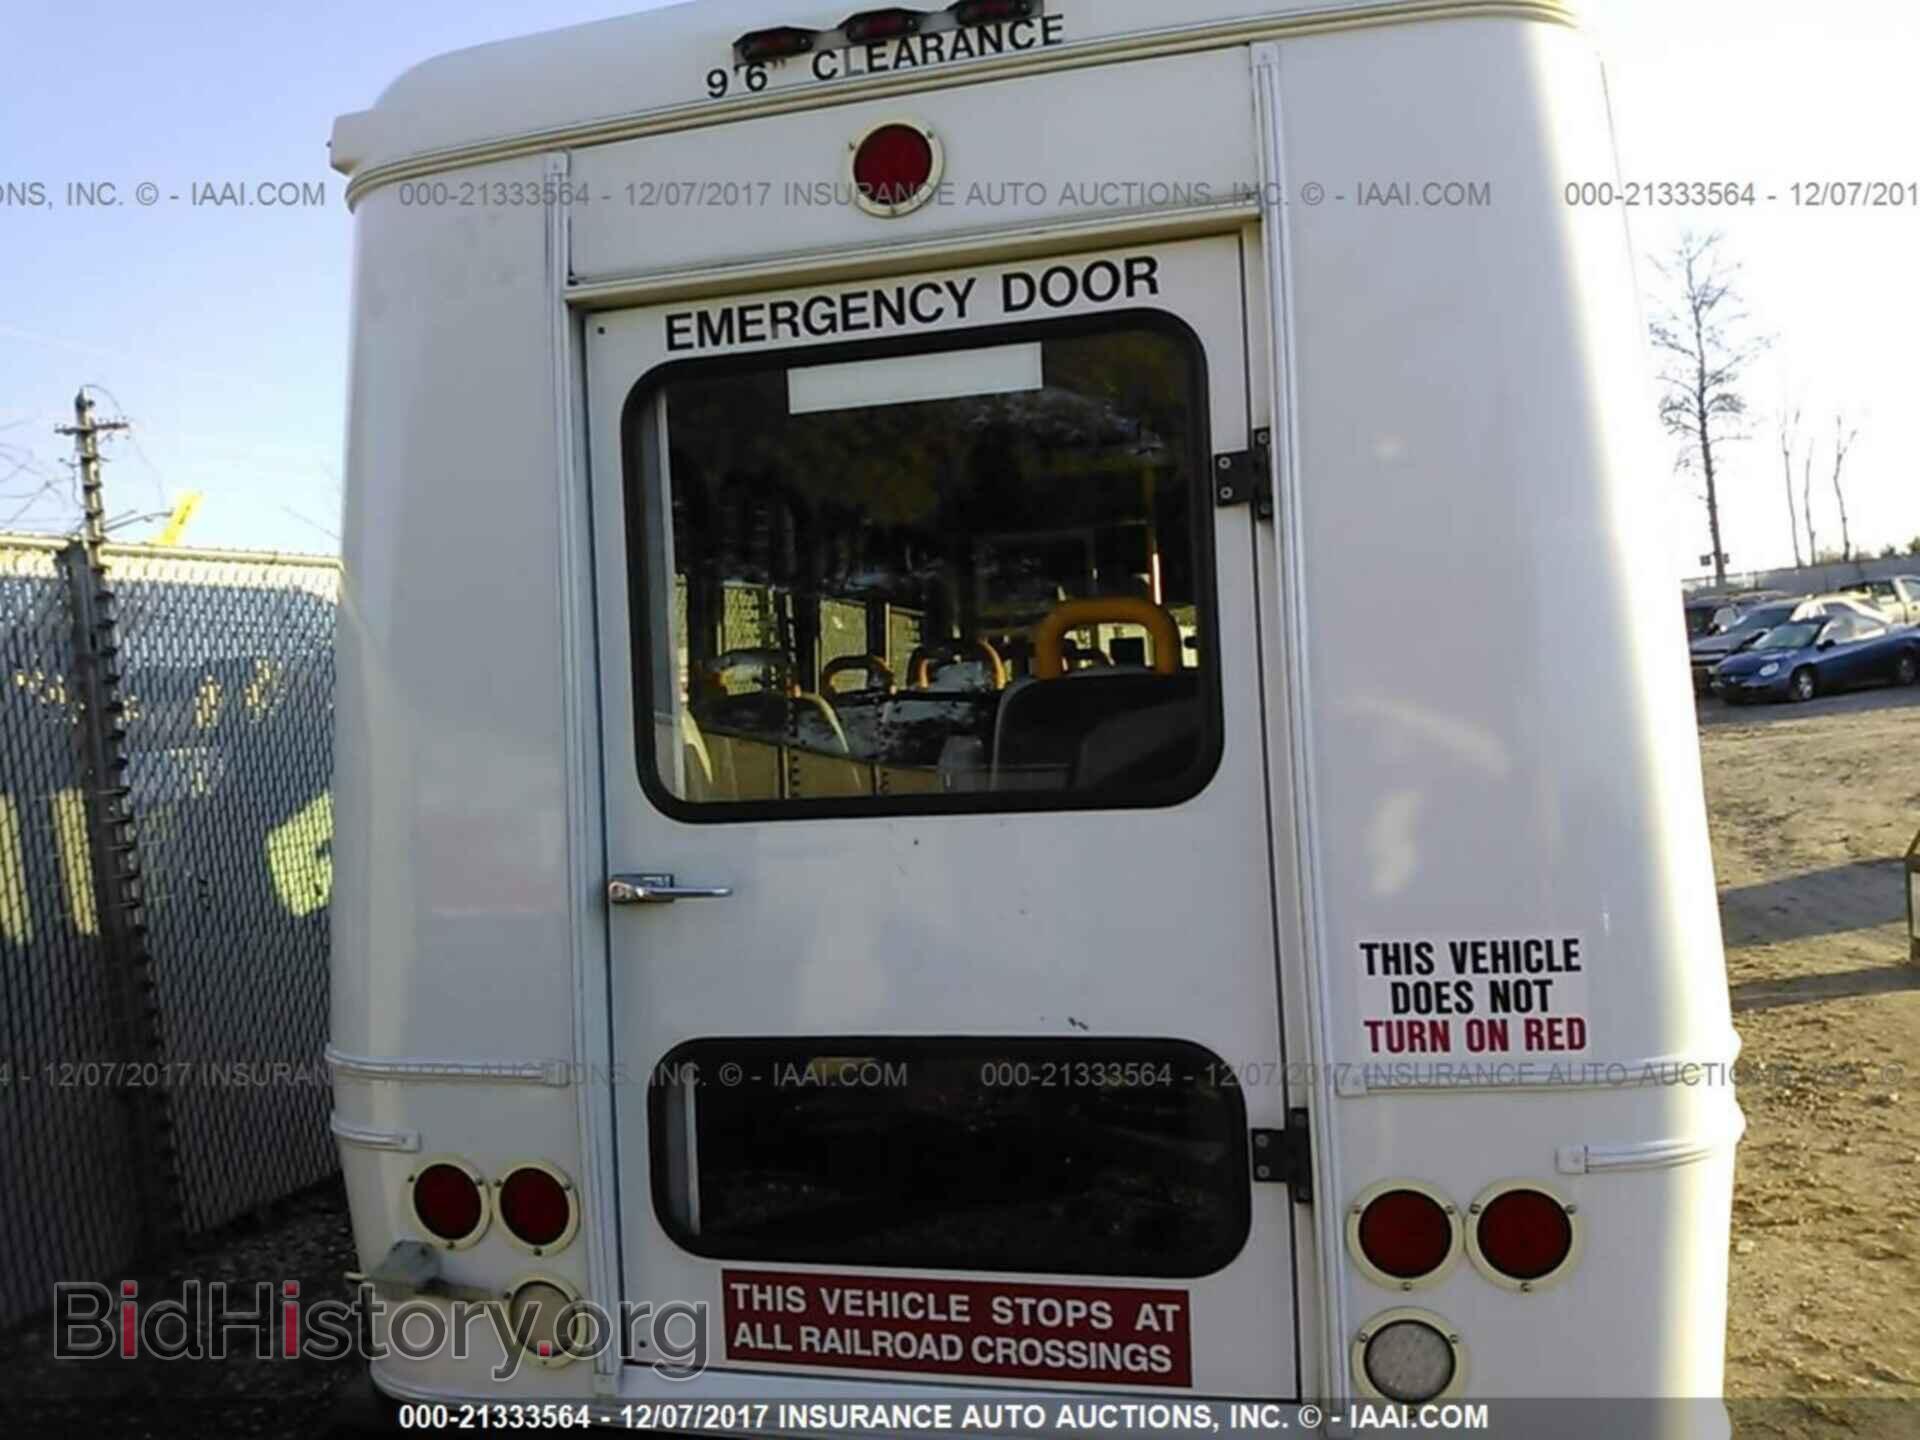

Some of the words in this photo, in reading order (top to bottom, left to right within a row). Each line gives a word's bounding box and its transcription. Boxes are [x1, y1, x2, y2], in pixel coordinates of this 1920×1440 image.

[811, 14, 1064, 80] CLEARANCE
[665, 277, 976, 352] EMERGENCY
[1002, 255, 1160, 313] DOOR
[1359, 941, 1435, 976] THIS
[1448, 938, 1582, 975] VEHICLE
[1391, 980, 1474, 1015] DOES
[1489, 979, 1553, 1013] NOT
[1363, 1020, 1450, 1053] TURN
[1465, 1018, 1508, 1052] ON
[1524, 1017, 1586, 1051] RED
[731, 1282, 806, 1314] THIS
[819, 1287, 970, 1323] VEHICLE
[991, 1297, 1113, 1330] STOPS
[1135, 1303, 1180, 1332] AT
[733, 1322, 793, 1352] ALL
[800, 1325, 962, 1362] RAILROAD
[971, 1338, 1172, 1374] CROSSINGS
